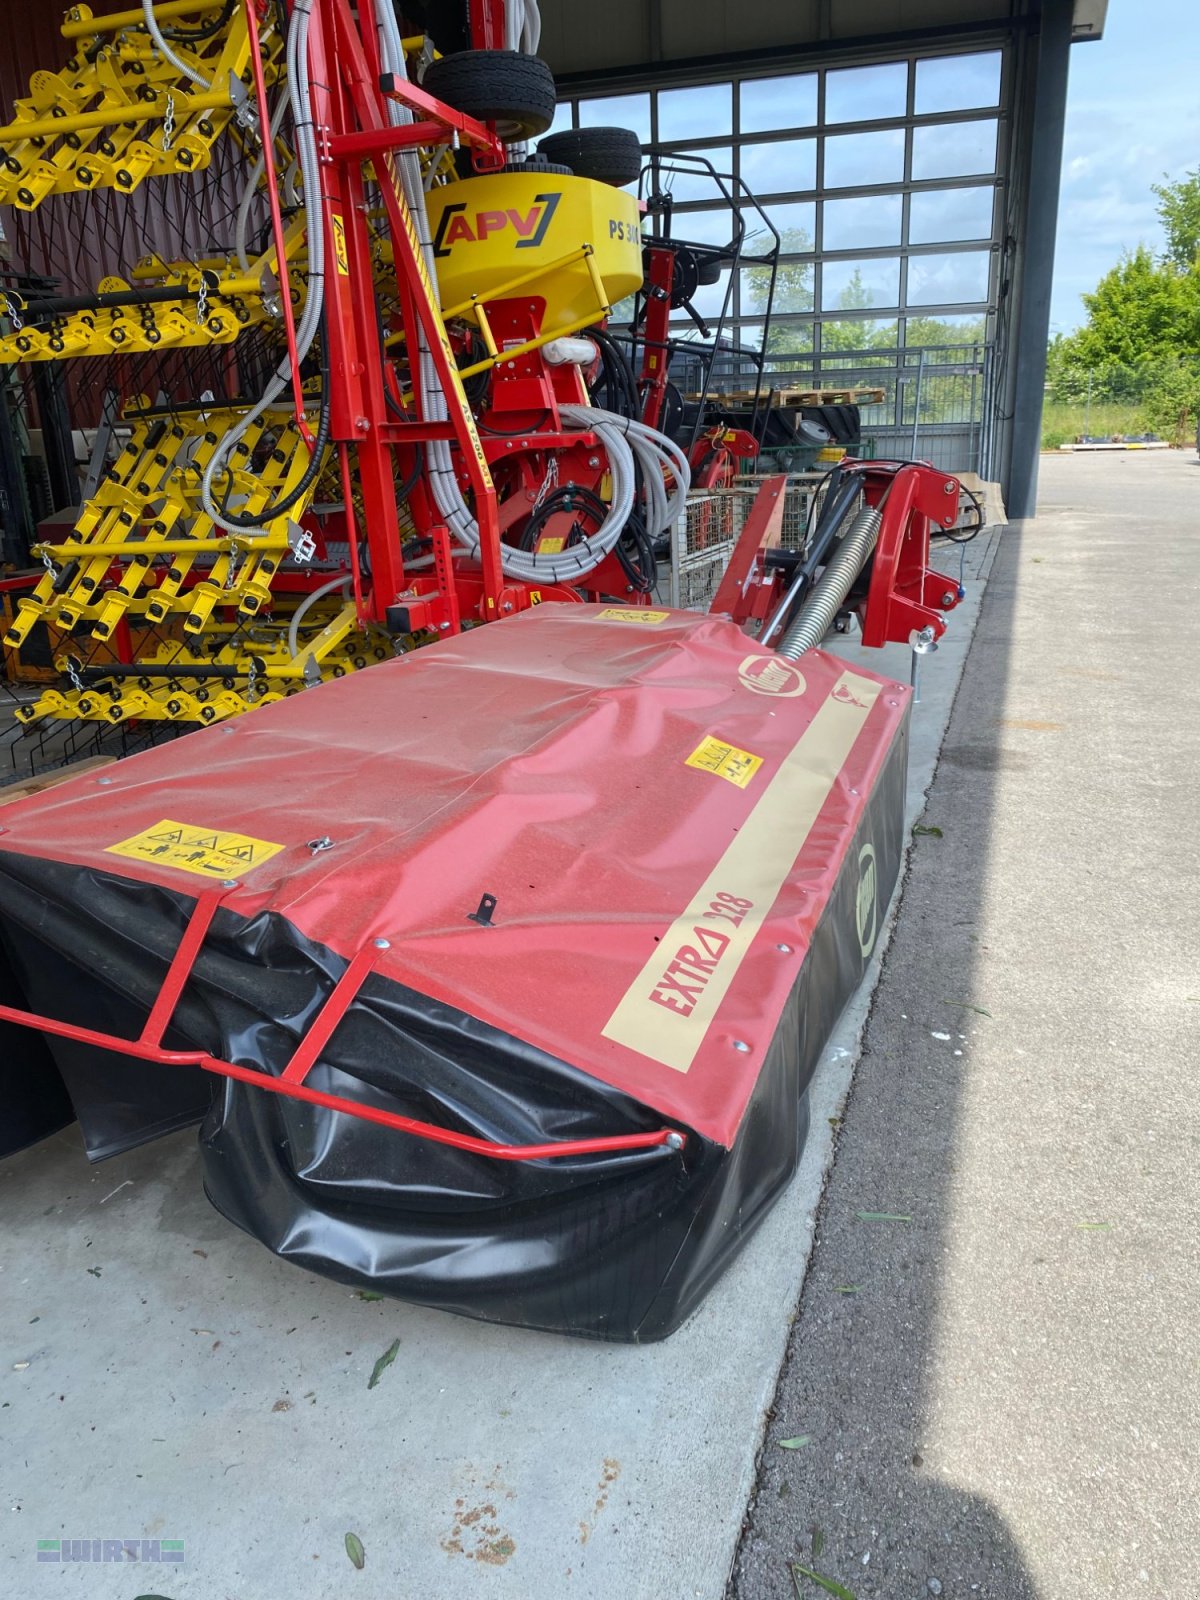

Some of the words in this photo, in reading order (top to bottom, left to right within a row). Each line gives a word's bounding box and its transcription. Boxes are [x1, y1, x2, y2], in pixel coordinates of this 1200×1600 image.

[609, 219, 625, 241] PS
[462, 404, 472, 423] AS
[470, 429, 483, 460] 1200
[648, 926, 731, 1018] EXTRA
[702, 892, 754, 928] 228
